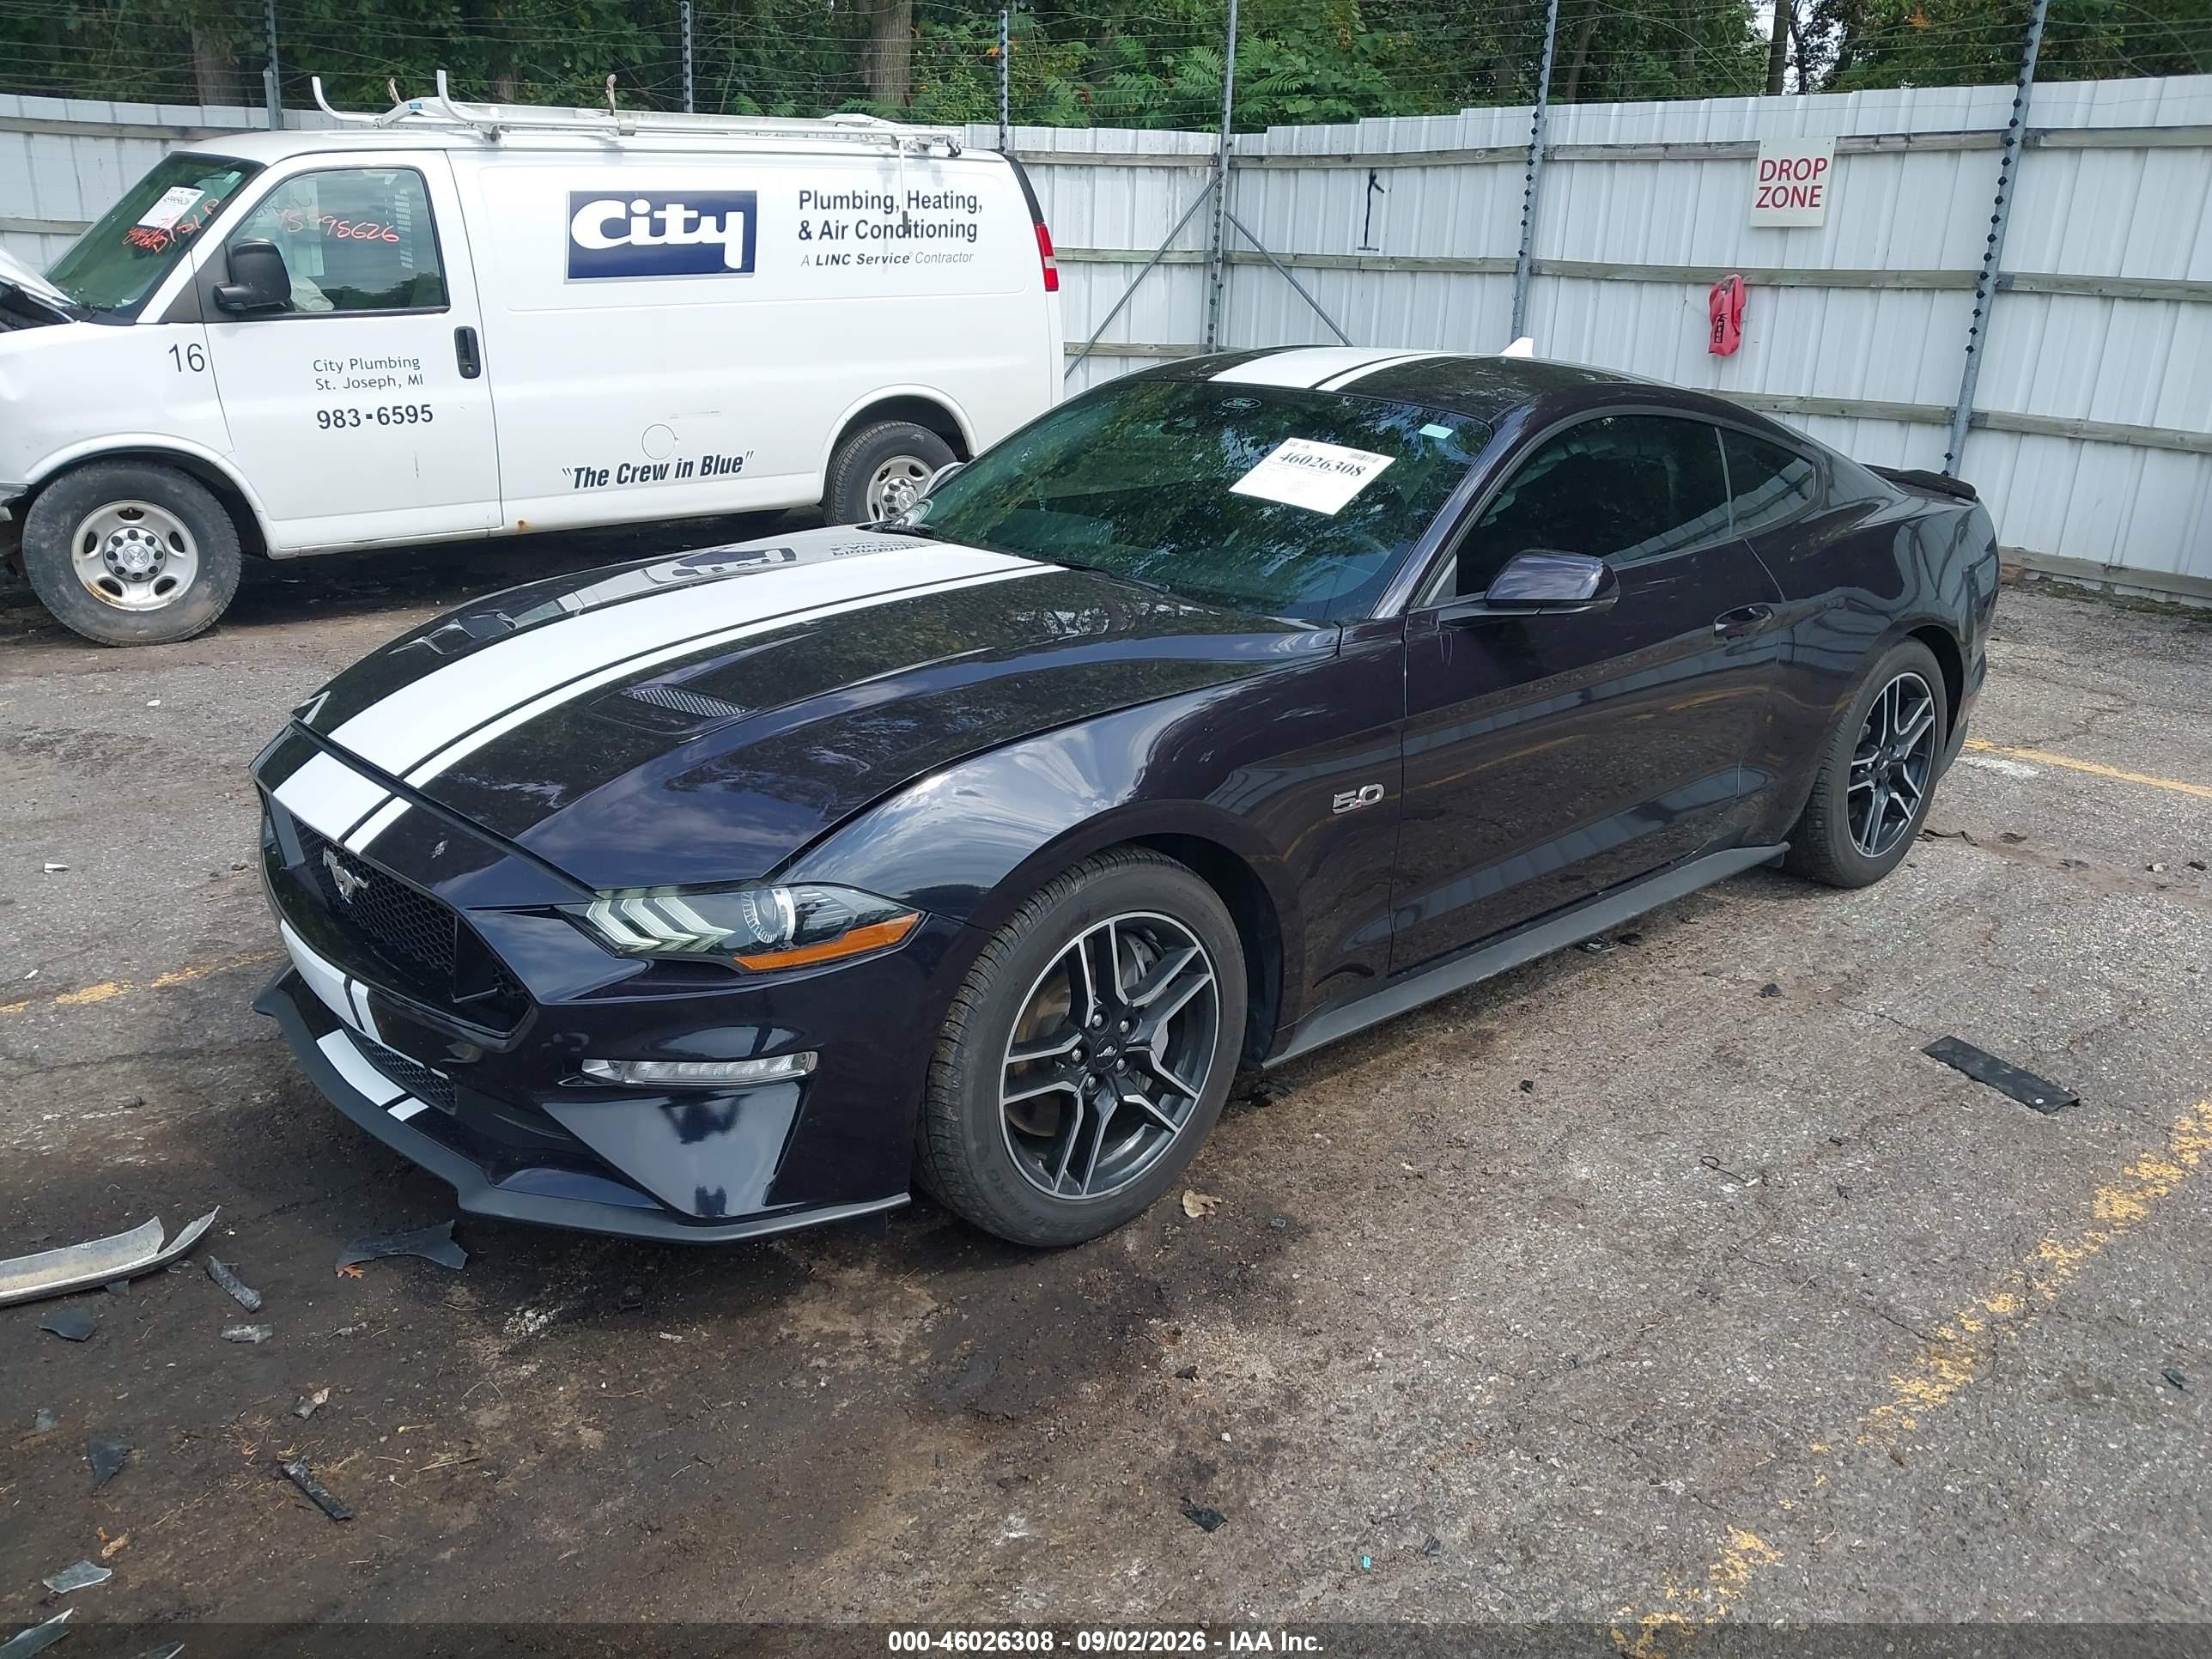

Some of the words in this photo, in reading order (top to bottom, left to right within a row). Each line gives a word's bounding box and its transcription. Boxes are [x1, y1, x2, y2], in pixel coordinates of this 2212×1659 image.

[1759, 157, 1828, 182] DROP
[799, 190, 900, 215] Plumbing,
[907, 190, 982, 215] Heating,
[1755, 185, 1823, 209] ZONE
[570, 198, 744, 270] City
[798, 220, 813, 240] &
[818, 219, 848, 240] Air
[854, 218, 978, 243] Conditioning
[800, 254, 810, 267] A
[816, 253, 851, 266] LINC
[915, 251, 974, 264] Contractor
[168, 343, 205, 373] 16
[313, 358, 344, 374] City
[349, 356, 421, 372] Plumbing
[315, 377, 337, 391] St.
[343, 374, 402, 391] Joseph,
[408, 373, 423, 386] MI
[616, 461, 671, 485] Crew
[674, 458, 695, 479] in
[1279, 451, 1366, 477] 46026308
